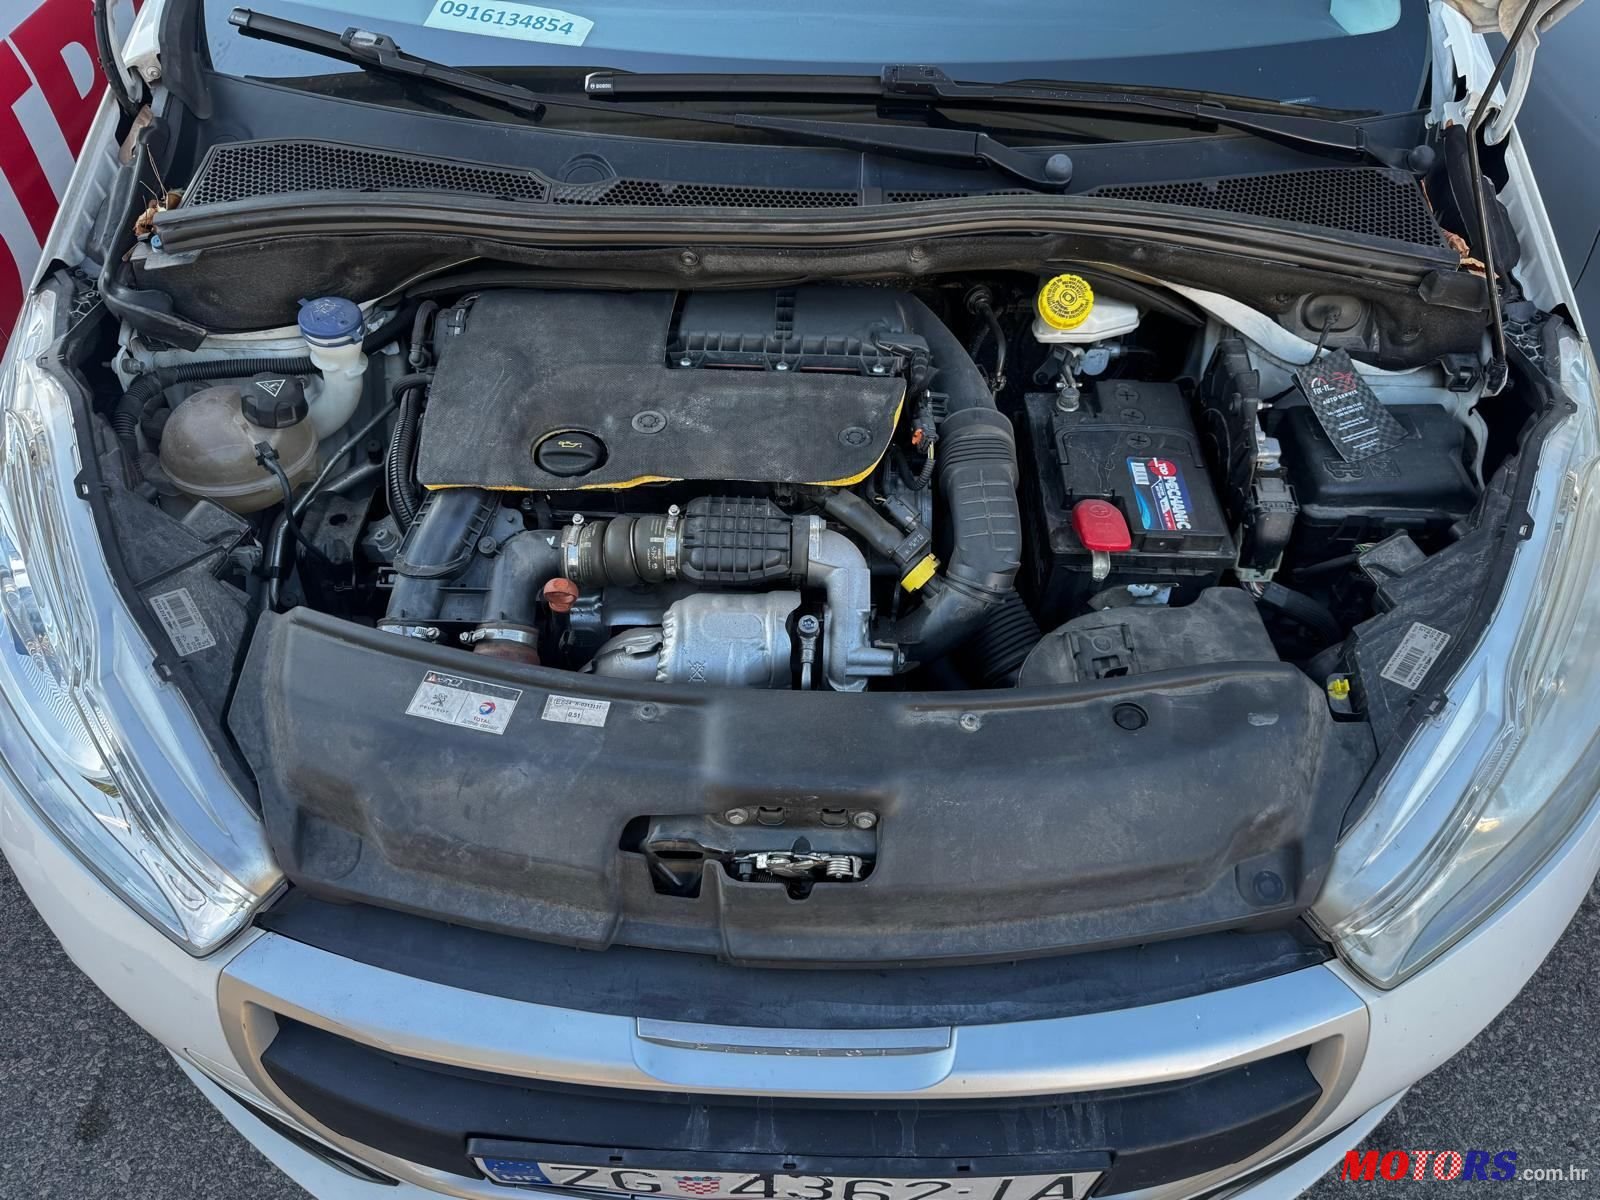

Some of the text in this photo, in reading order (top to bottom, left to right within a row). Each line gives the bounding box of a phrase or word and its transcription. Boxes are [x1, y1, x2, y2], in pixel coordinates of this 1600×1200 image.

[439, 1, 575, 36] 0916134854
[1322, 395, 1338, 405] AUTO
[1163, 476, 1192, 529] MECHANIC
[473, 716, 491, 724] TOTAL
[551, 1166, 662, 1193] ZG
